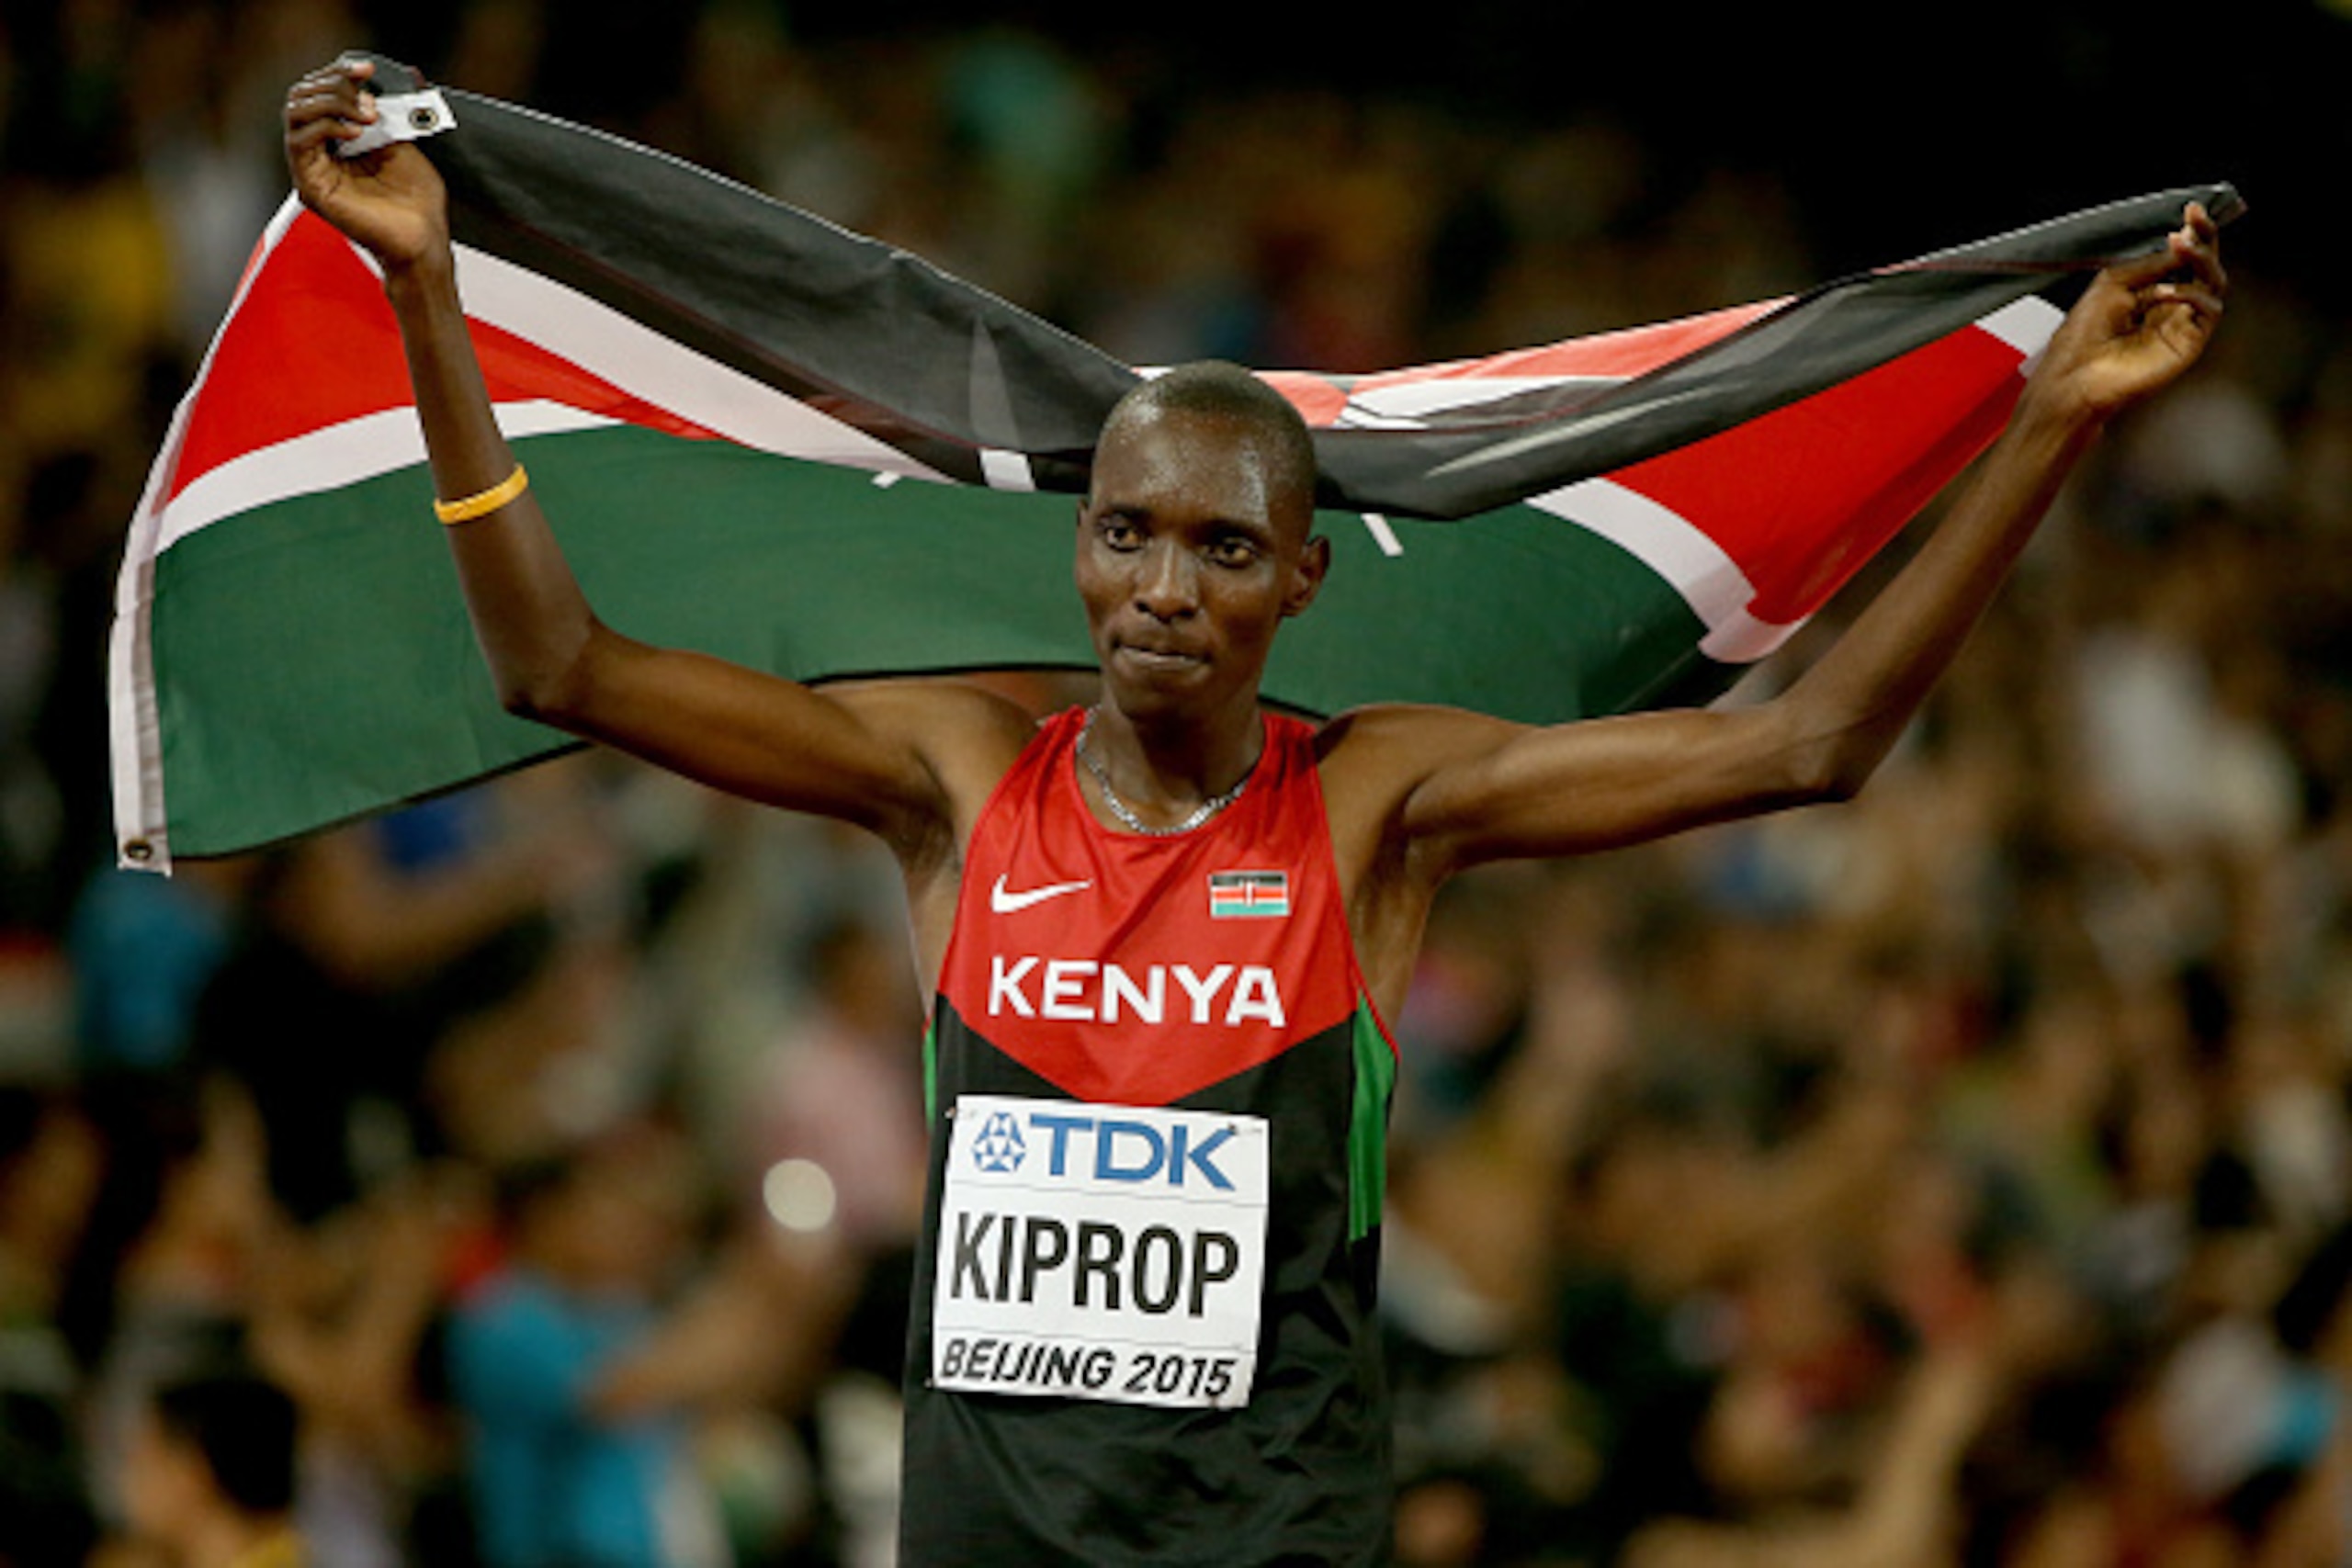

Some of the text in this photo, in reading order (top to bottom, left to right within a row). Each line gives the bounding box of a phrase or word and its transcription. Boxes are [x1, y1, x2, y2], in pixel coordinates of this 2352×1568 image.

[988, 955, 1286, 1028] KENYA
[1029, 1112, 1237, 1191] TDK
[950, 1212, 1239, 1318] KIPROP
[941, 1338, 1238, 1397] BEIJING 2015
